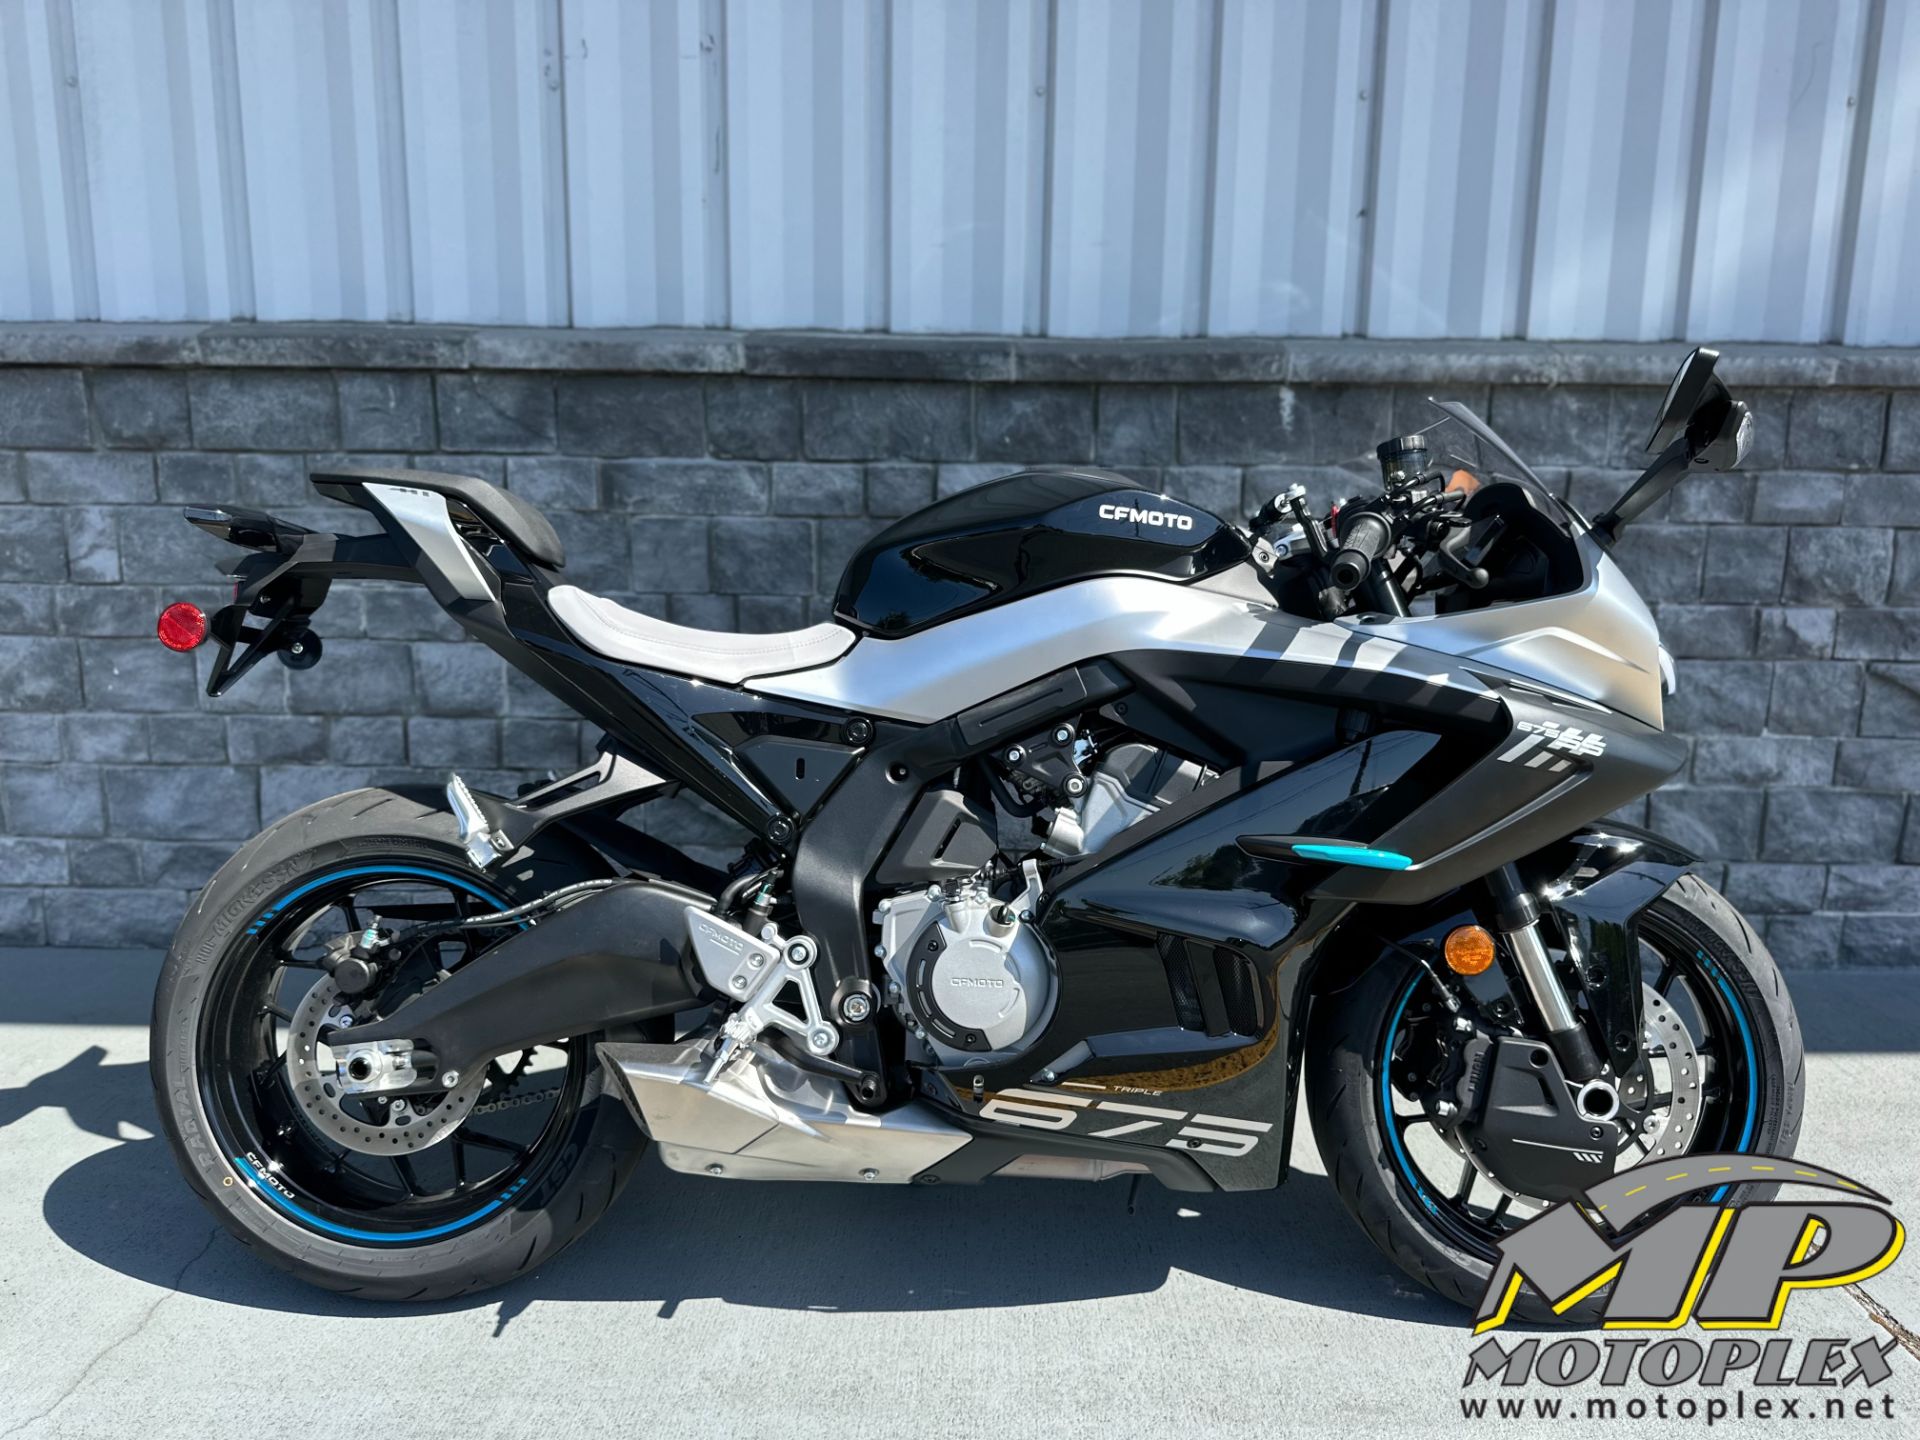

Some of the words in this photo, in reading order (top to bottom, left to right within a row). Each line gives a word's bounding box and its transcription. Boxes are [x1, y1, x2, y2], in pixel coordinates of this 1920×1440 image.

[1099, 504, 1193, 531] CFMOTO
[698, 923, 744, 952] CFMOTO
[950, 978, 1004, 988] CFMOTO
[1113, 1085, 1163, 1096] TRIPLE
[979, 1088, 1274, 1157] 675
[246, 1151, 296, 1199] CFMOTO
